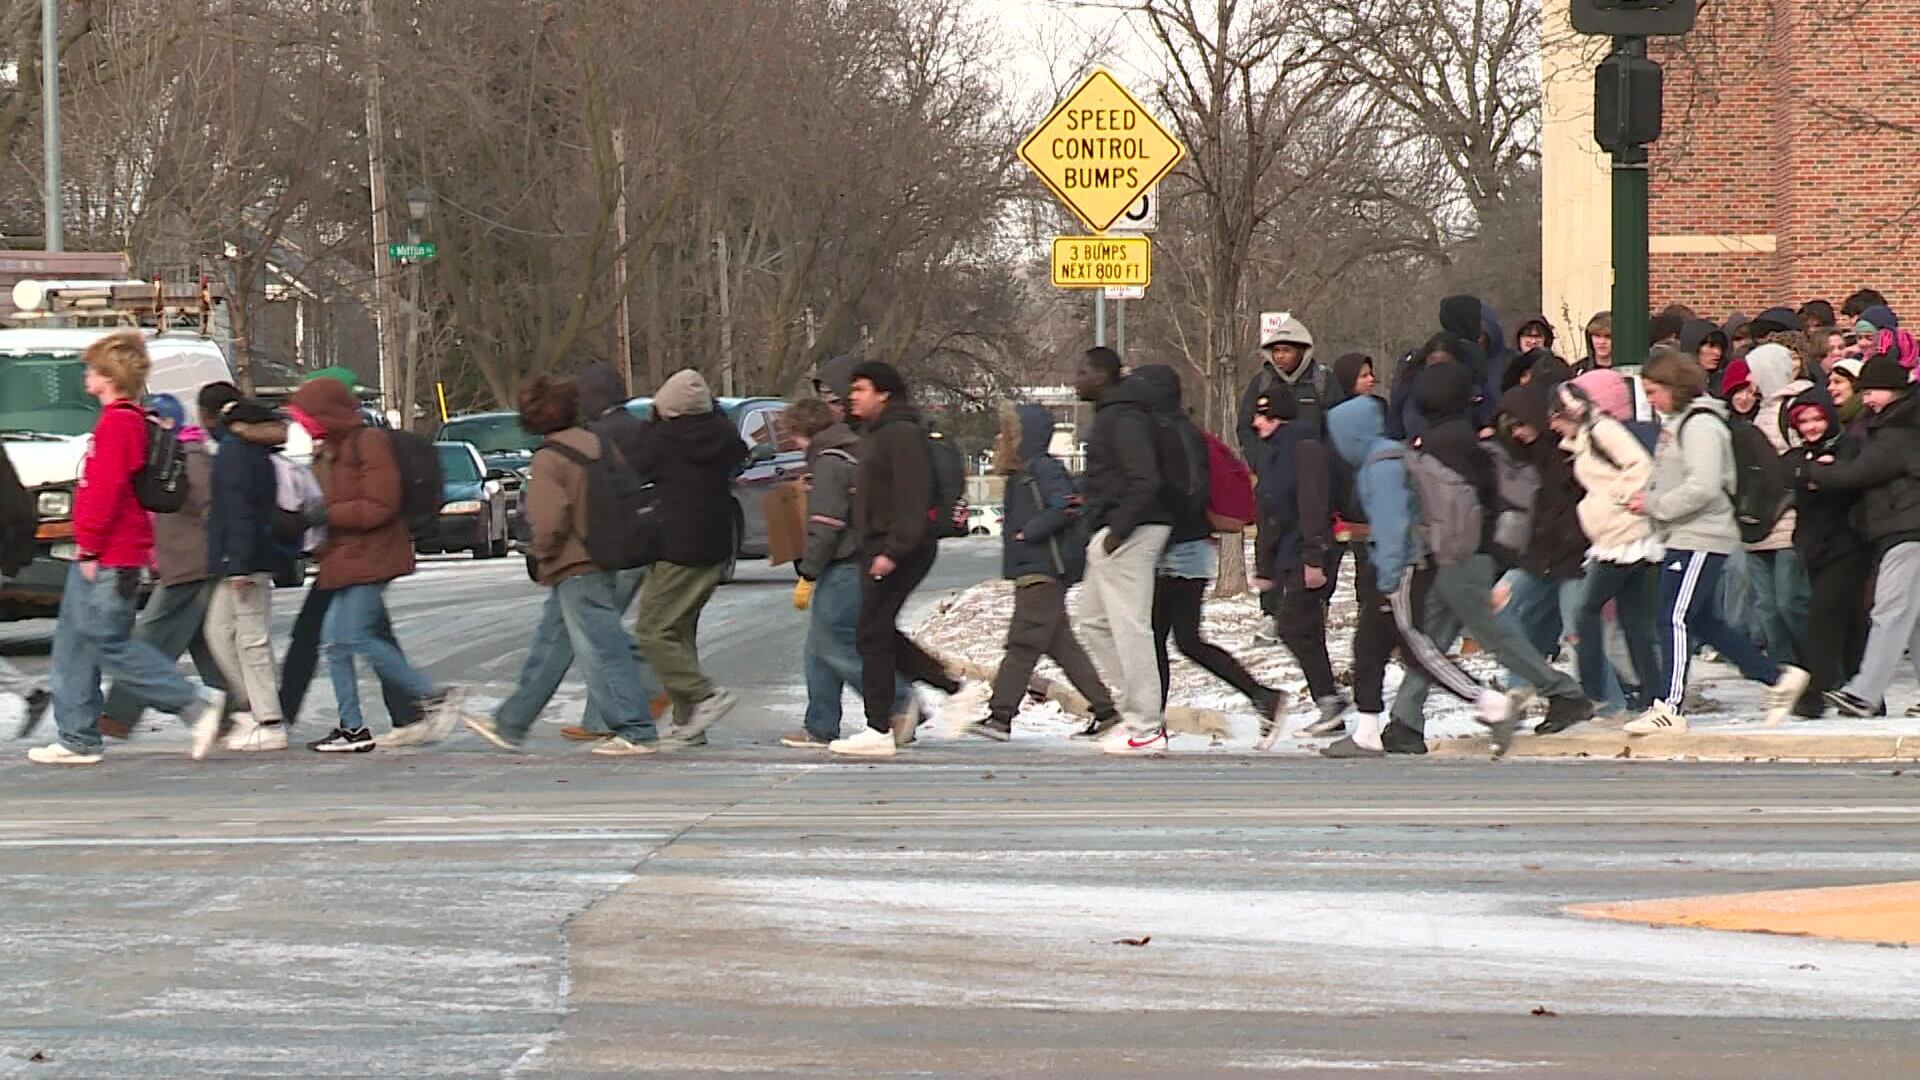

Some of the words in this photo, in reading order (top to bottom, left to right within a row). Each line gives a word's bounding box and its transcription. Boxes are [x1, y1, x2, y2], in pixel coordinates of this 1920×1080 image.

[1066, 109, 1136, 131] SPEED
[1052, 138, 1150, 159] CONTROL
[1064, 167, 1139, 190] BUMPS
[1070, 246, 1079, 261] 3
[1084, 245, 1127, 261] BUMPS
[1061, 262, 1092, 279] NEXT
[1095, 262, 1122, 279] 800
[1126, 262, 1140, 279] FT
